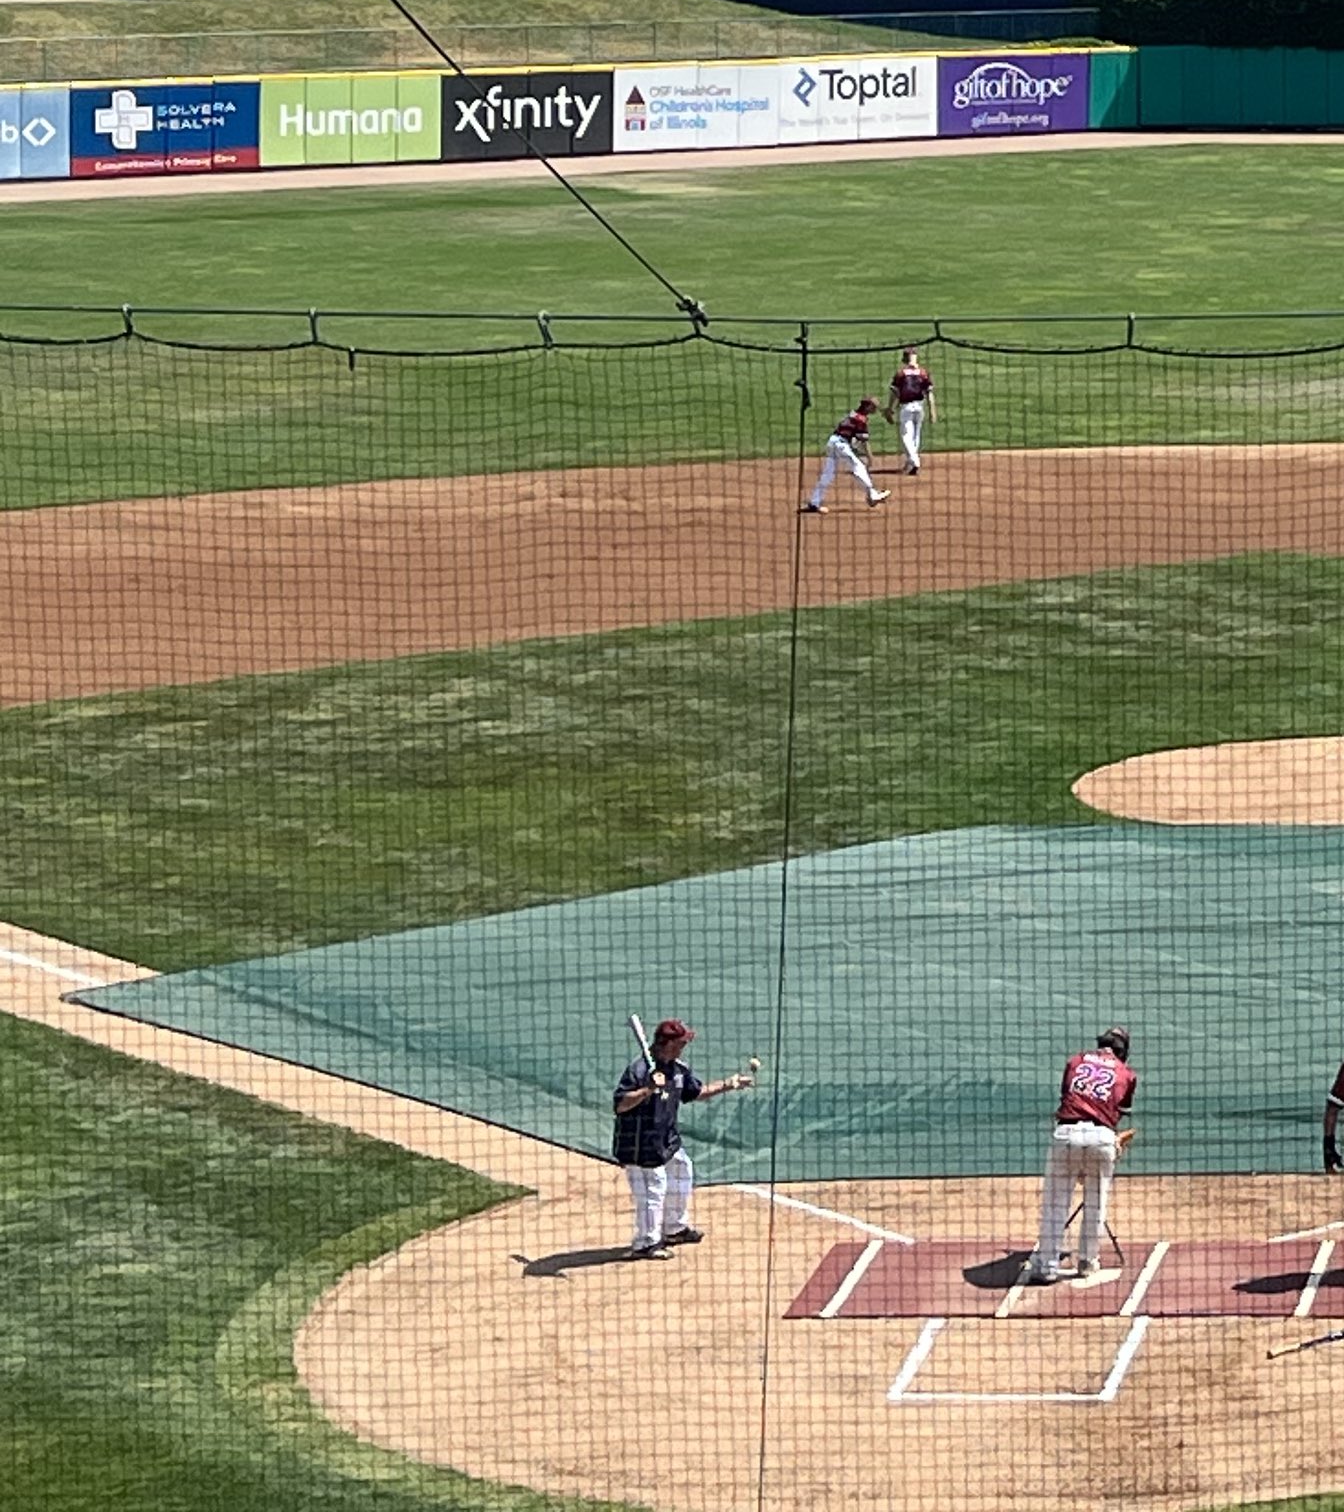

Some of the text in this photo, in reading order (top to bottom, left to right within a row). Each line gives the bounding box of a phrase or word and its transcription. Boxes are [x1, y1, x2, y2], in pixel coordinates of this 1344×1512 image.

[819, 65, 917, 106] Toptal
[157, 101, 236, 116] SOLVERA
[279, 103, 423, 136] Humana
[455, 85, 601, 142] xfinity
[1072, 1063, 1114, 1100] 22
